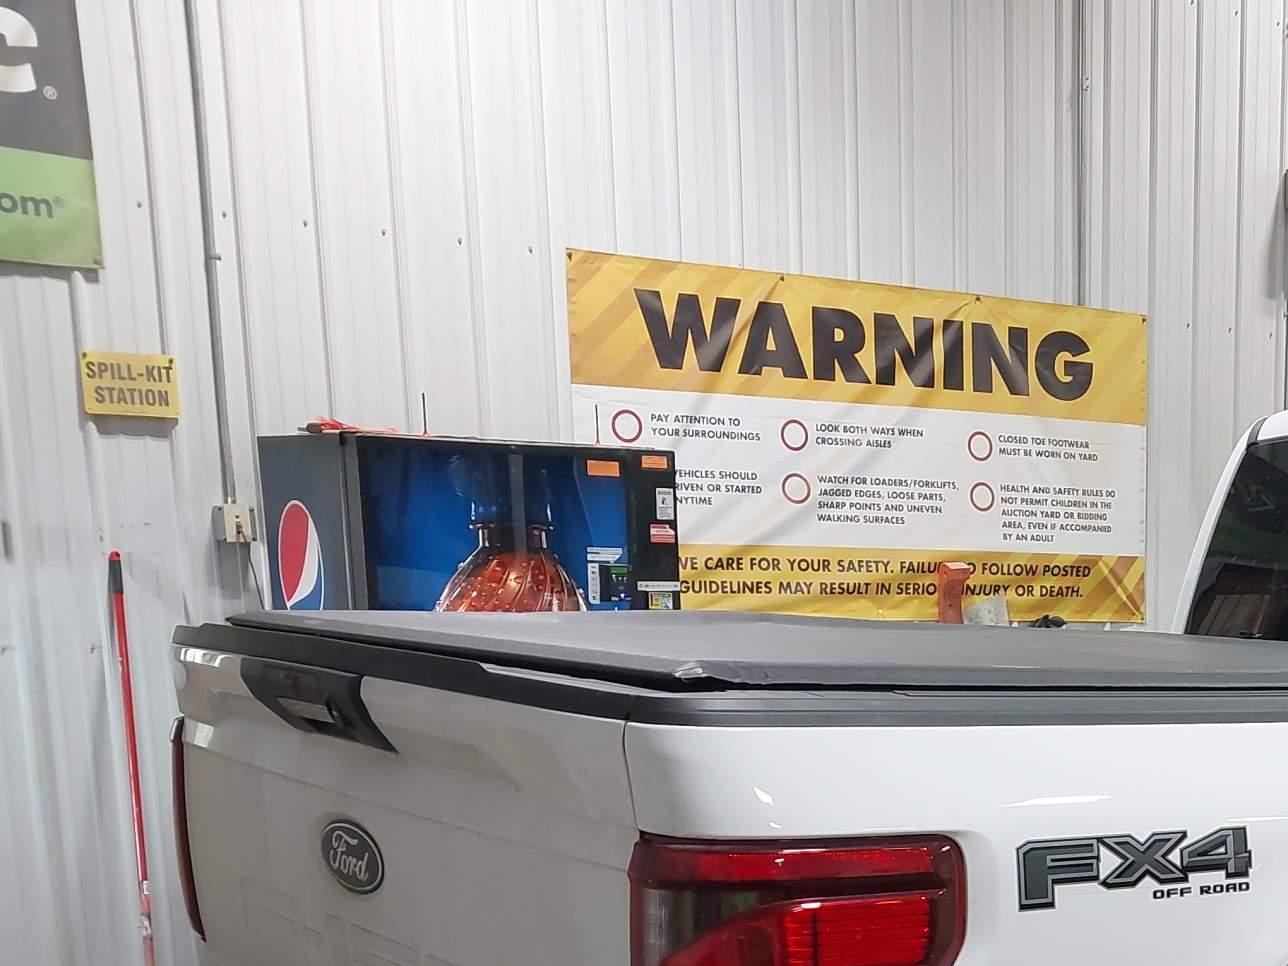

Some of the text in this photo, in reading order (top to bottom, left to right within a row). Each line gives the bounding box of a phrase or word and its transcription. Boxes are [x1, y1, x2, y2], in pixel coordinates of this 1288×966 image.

[634, 287, 1094, 401] WARNING
[85, 361, 173, 383] SPILL-KIT
[94, 386, 169, 407] STATION
[650, 413, 740, 427] PAY ATTENTION TO
[651, 428, 761, 441] YOUR SURROUNDINGS
[815, 423, 923, 437] LOOK BOTH WAYS WHEN
[815, 437, 892, 448] CROSSING AISLES
[998, 435, 1090, 449] CLOSED TOE FOOTWEAR
[998, 447, 1098, 462] MUST BE WORN ON YARD
[719, 471, 757, 481] SHOULD
[817, 475, 959, 491] WATCH FOR LOADERS/FORKLIFTS,
[674, 482, 762, 494] RIVEN OR STARTED
[1000, 484, 1115, 498] HEALTH AND SAFETY RULES DO
[676, 496, 713, 505] NYTIME
[818, 488, 946, 503] JAGGED EDGES, LOOSE PARTS,
[817, 500, 942, 514] SHARP POINTS AND UNEVEN
[1001, 497, 1018, 505] NOT
[1020, 498, 1048, 507] PERMIT
[1051, 499, 1087, 509] CHILDREN
[1089, 501, 1098, 509] IN
[817, 513, 905, 524] WALKING SURFACES
[1001, 509, 1037, 518] AUCTION
[1040, 511, 1061, 519] YARD
[1077, 512, 1107, 521] BIDDING
[1002, 521, 1025, 530] AREA,
[1028, 522, 1048, 530] EVEN
[1059, 524, 1112, 533] ACCOMPANIED
[1002, 533, 1013, 541] BY
[1030, 534, 1055, 542] ADULT
[704, 557, 744, 570] CARE
[750, 558, 781, 571] FOR
[786, 558, 831, 572] YOUR
[837, 559, 894, 574] SAFETY.
[899, 561, 943, 574] FAILU
[982, 562, 1038, 577] FOLLOW
[1042, 564, 1091, 578] POSTED
[679, 580, 772, 594] GUIDELINES
[778, 582, 814, 595] MAY
[819, 581, 872, 595] RESULT
[875, 583, 891, 595] IN
[896, 582, 938, 595] SERIO
[961, 583, 1010, 597] INJURY
[1015, 584, 1035, 597] OR
[1040, 585, 1083, 598] DEATH.
[325, 826, 369, 881] Ford
[1016, 825, 1253, 912] FX4
[1152, 882, 1250, 900] OFF ROAD
